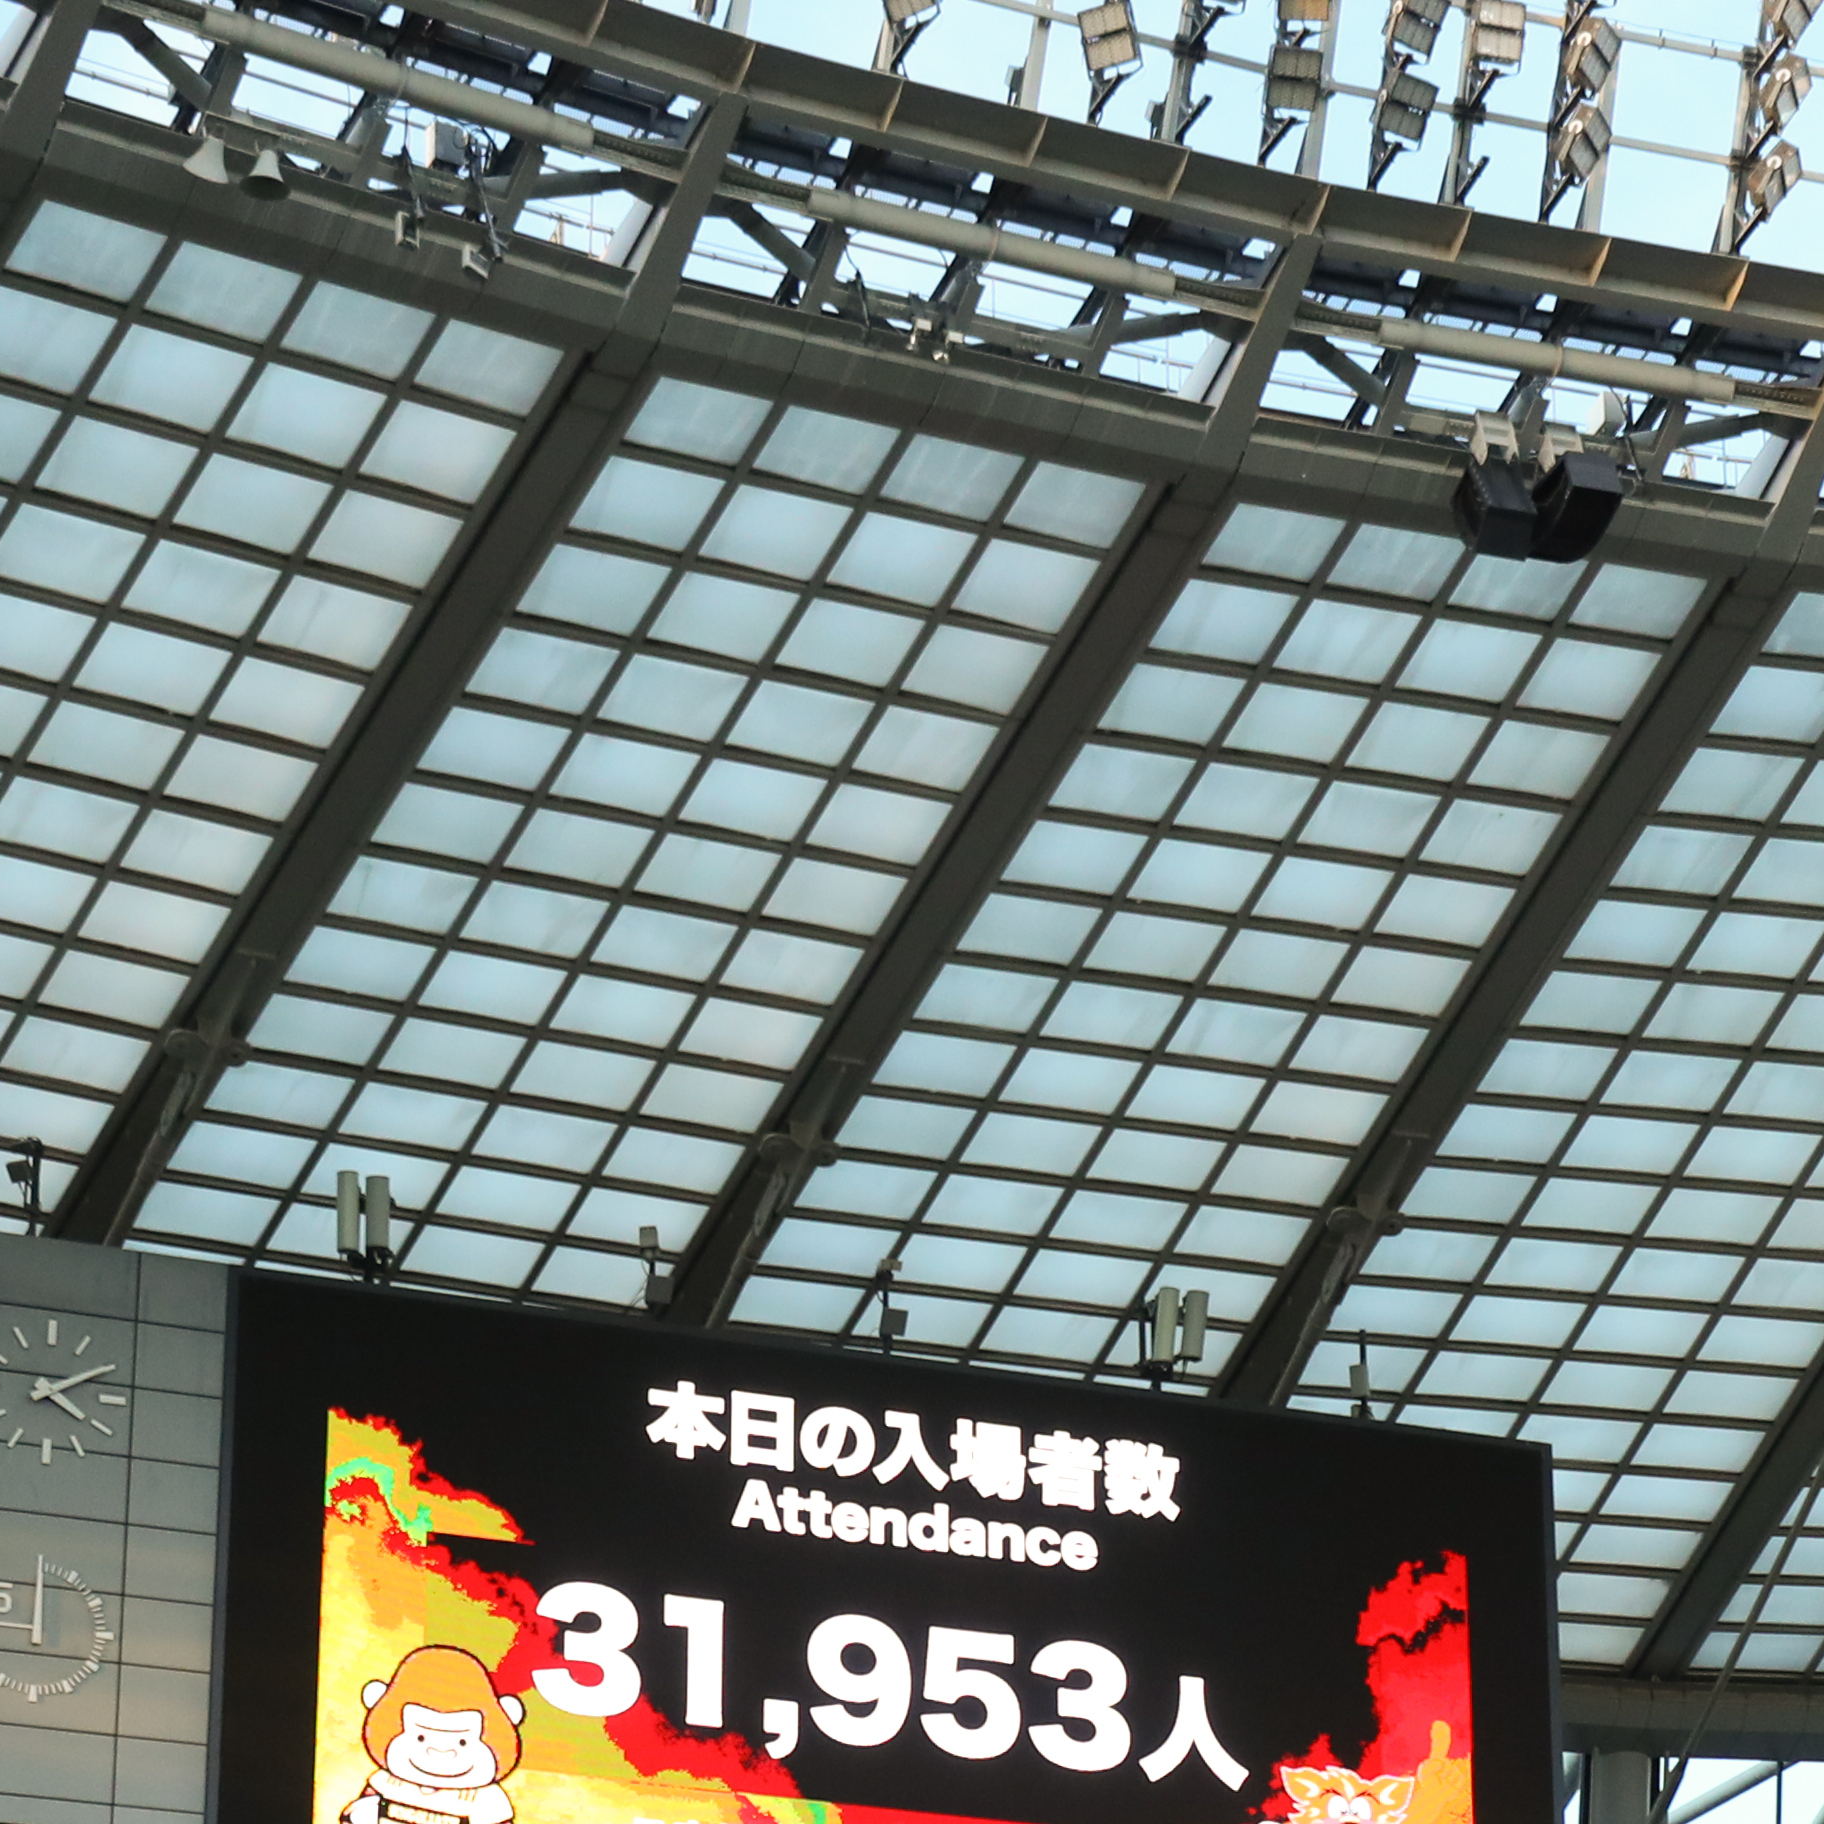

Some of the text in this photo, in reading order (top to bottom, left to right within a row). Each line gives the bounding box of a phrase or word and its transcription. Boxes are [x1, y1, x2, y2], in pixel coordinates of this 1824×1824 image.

[646, 1380, 1181, 1521] 本日の入場者数
[731, 1479, 1100, 1571] Attendance
[531, 1580, 1250, 1792] 31,953人
